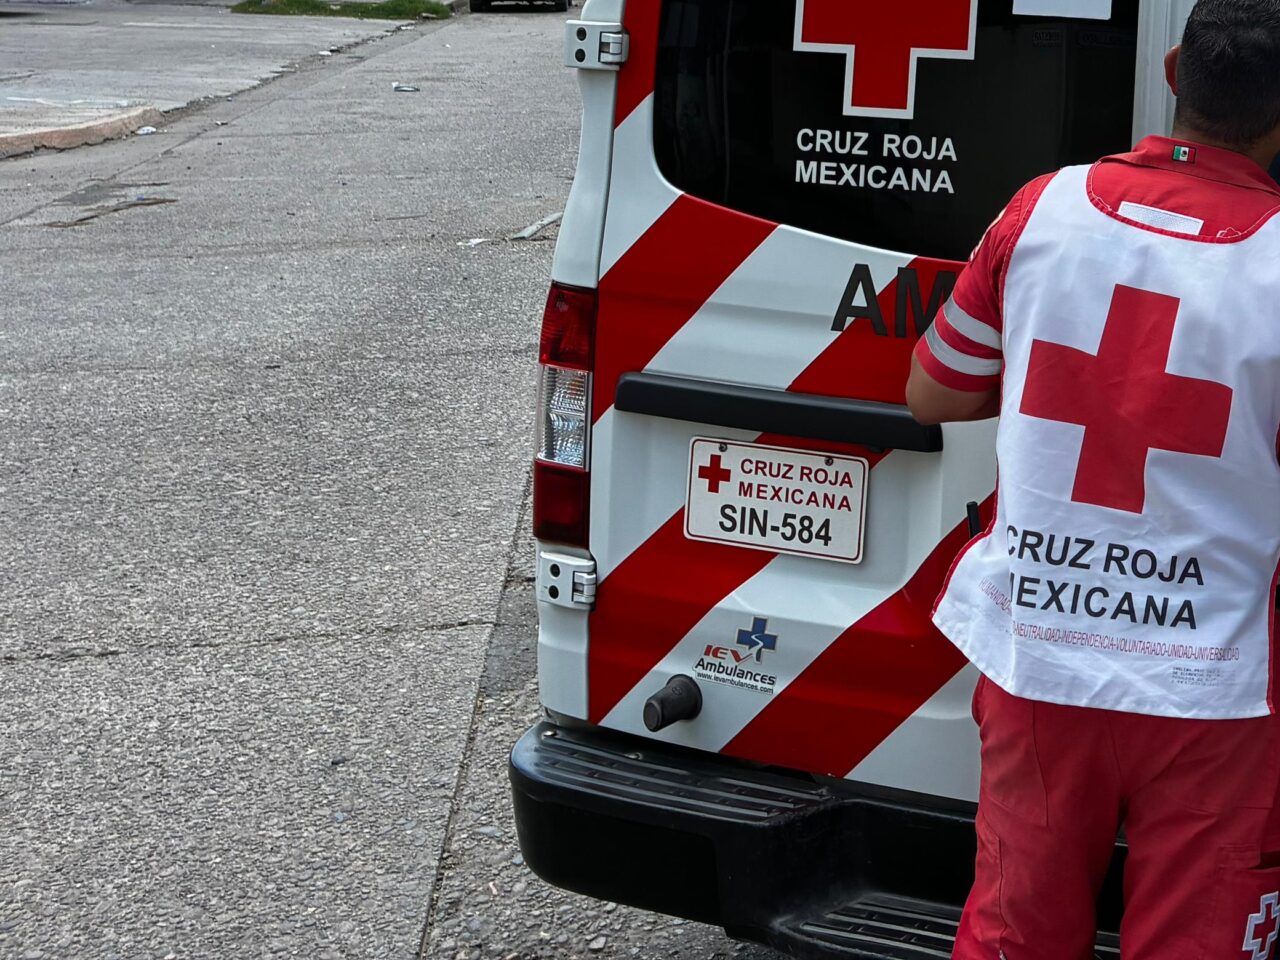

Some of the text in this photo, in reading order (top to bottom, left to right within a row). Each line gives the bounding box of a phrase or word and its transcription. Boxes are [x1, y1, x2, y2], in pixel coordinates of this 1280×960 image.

[797, 128, 958, 161] CRUZ ROJA
[795, 160, 955, 193] MEXICANA
[740, 458, 854, 488] CRUZ ROJA
[738, 481, 853, 512] MEXICANA
[718, 504, 833, 547] SIN-584
[1103, 543, 1205, 586] ROJA
[694, 657, 777, 686] Ambulances
